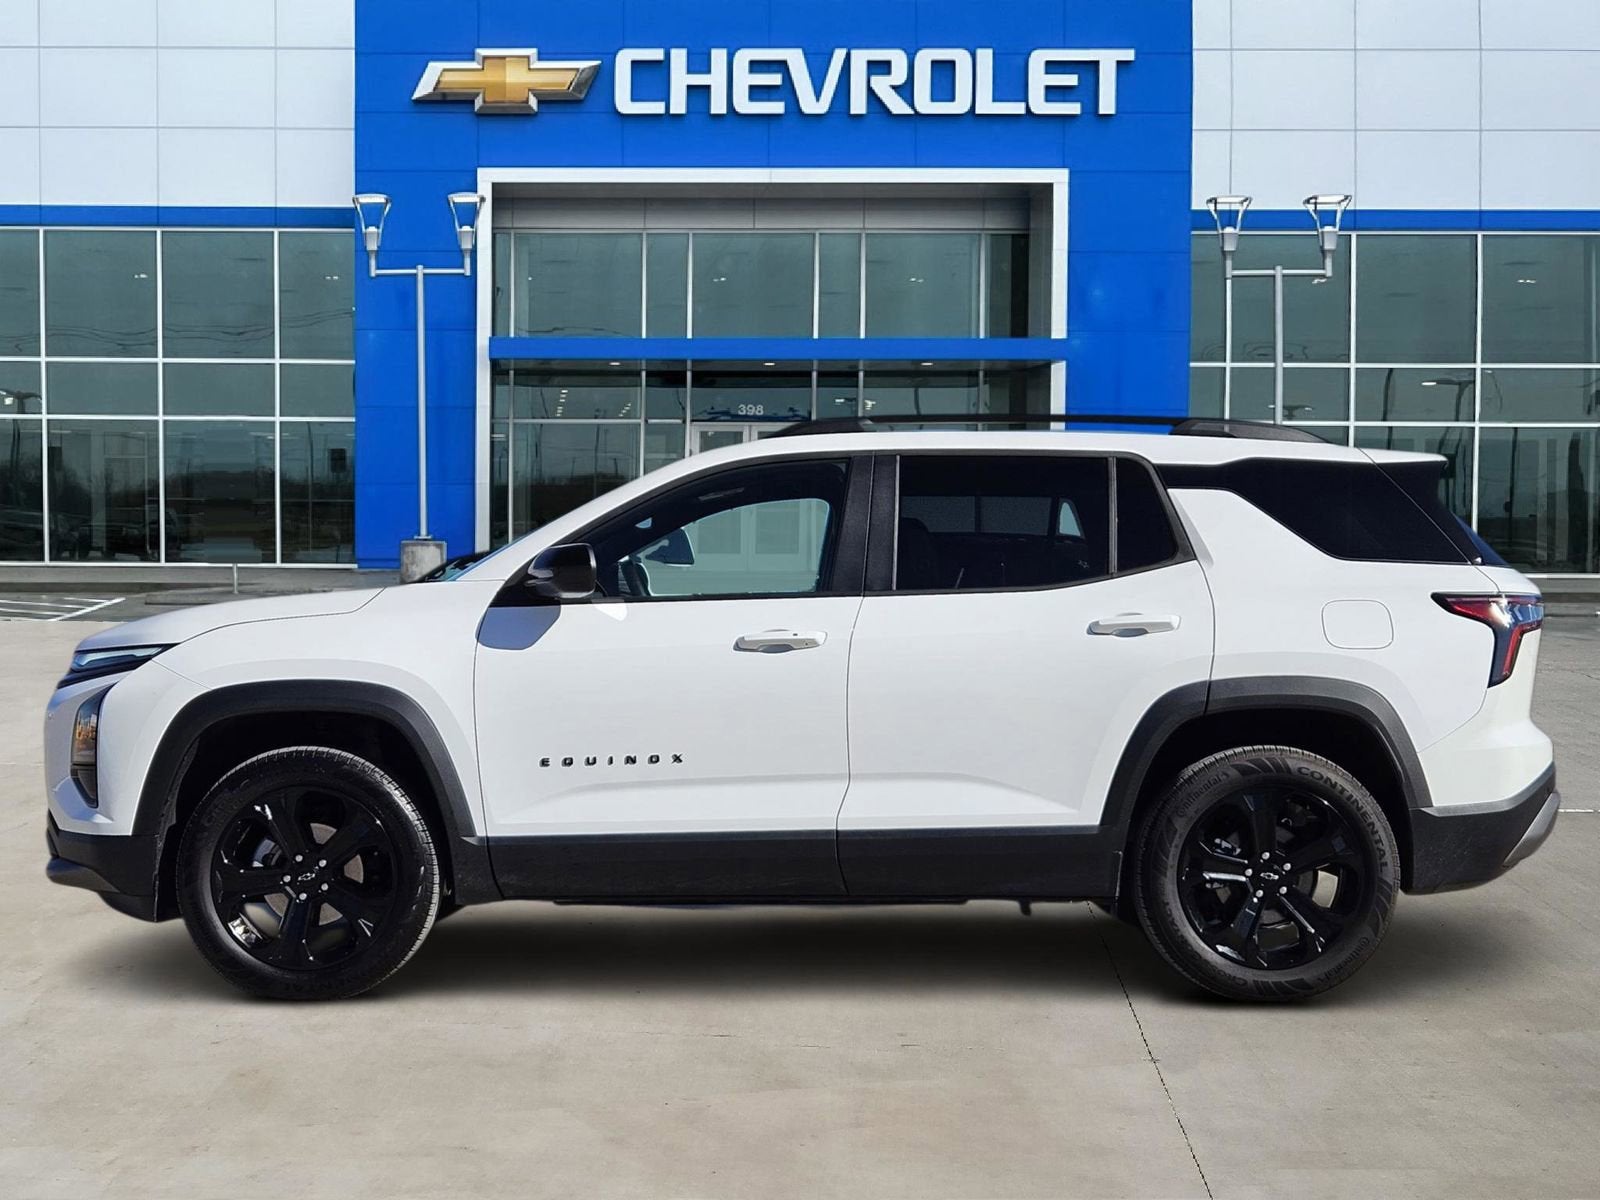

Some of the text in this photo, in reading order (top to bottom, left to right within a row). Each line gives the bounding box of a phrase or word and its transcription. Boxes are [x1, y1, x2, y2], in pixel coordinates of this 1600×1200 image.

[614, 47, 1136, 115] CHEVROLET
[738, 403, 764, 416] 398
[539, 753, 684, 768] EQUINOX
[1297, 766, 1387, 872] CONTINENTAL
